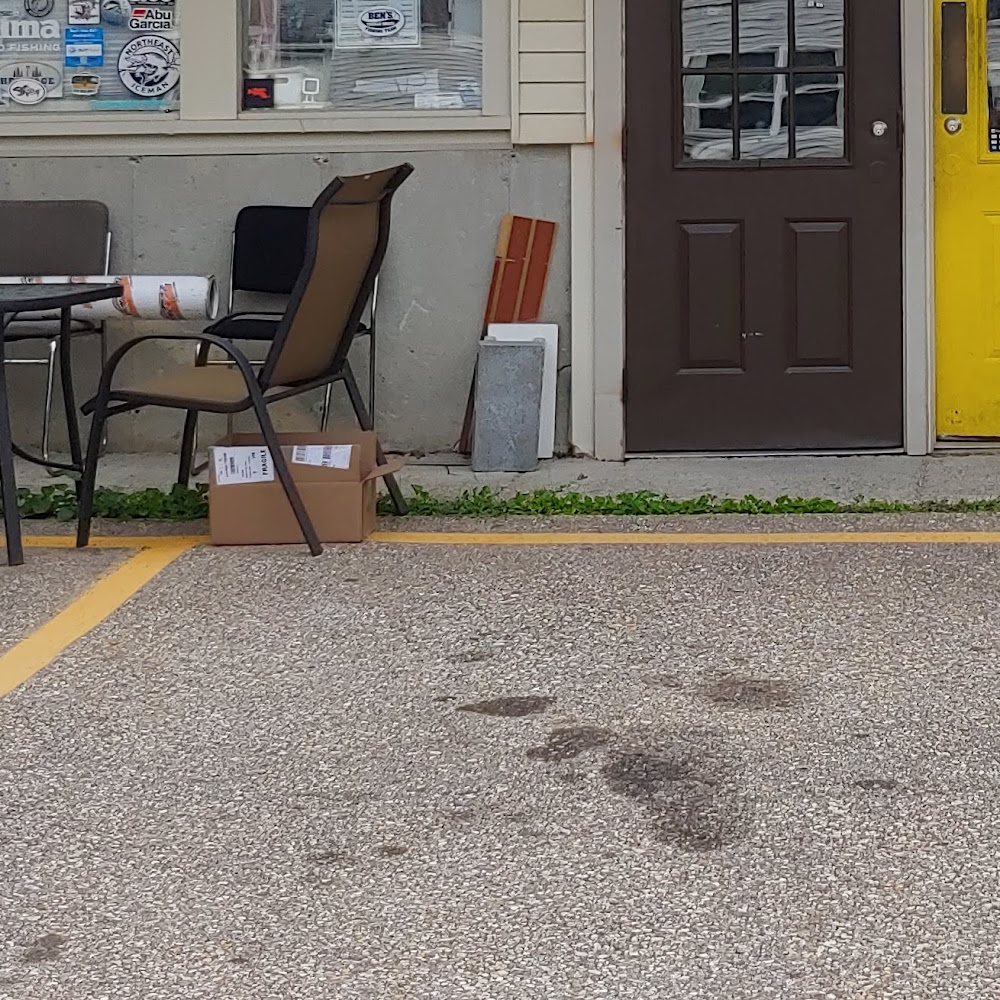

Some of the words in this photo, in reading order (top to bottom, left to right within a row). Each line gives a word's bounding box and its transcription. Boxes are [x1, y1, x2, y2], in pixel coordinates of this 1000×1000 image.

[145, 9, 171, 19] Abu
[368, 11, 393, 20] BEN'S
[130, 19, 171, 29] Garcia
[8, 43, 60, 51] FISHING
[125, 39, 174, 56] NORTHEAST
[131, 81, 169, 93] ICEMAN
[260, 449, 269, 476] FRAGILE
